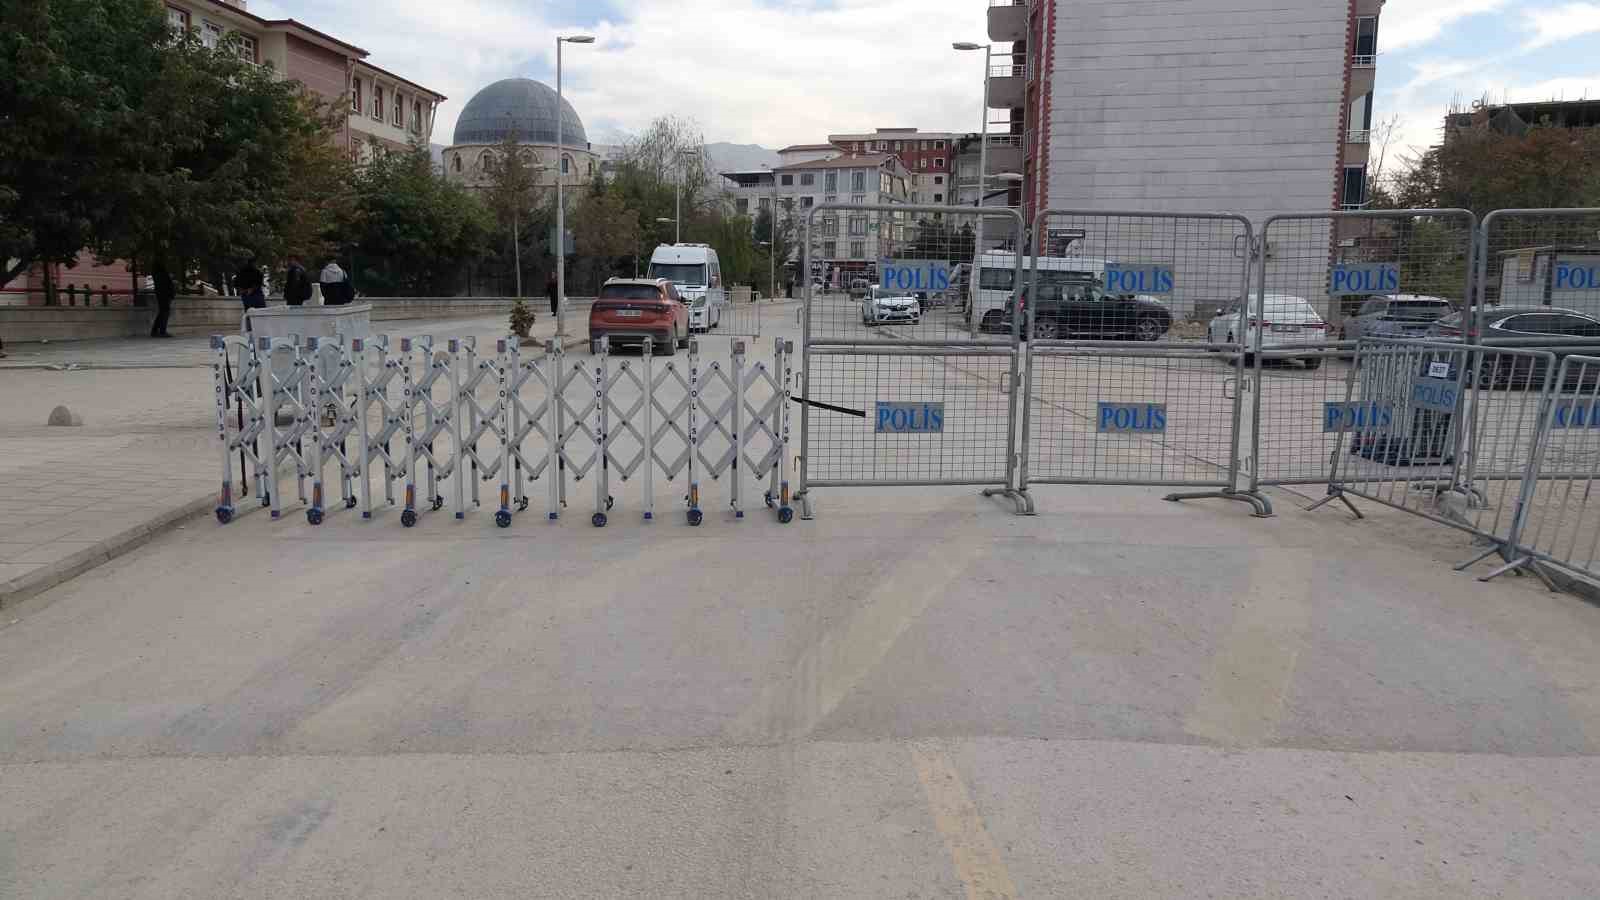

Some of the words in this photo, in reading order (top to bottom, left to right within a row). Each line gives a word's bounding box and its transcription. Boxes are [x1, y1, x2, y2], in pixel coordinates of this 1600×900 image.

[884, 262, 949, 289] POLİS
[1106, 266, 1172, 292] POLİS
[1333, 265, 1398, 291] POLİS
[880, 404, 942, 430] POLİS
[1101, 403, 1166, 429] POLİS
